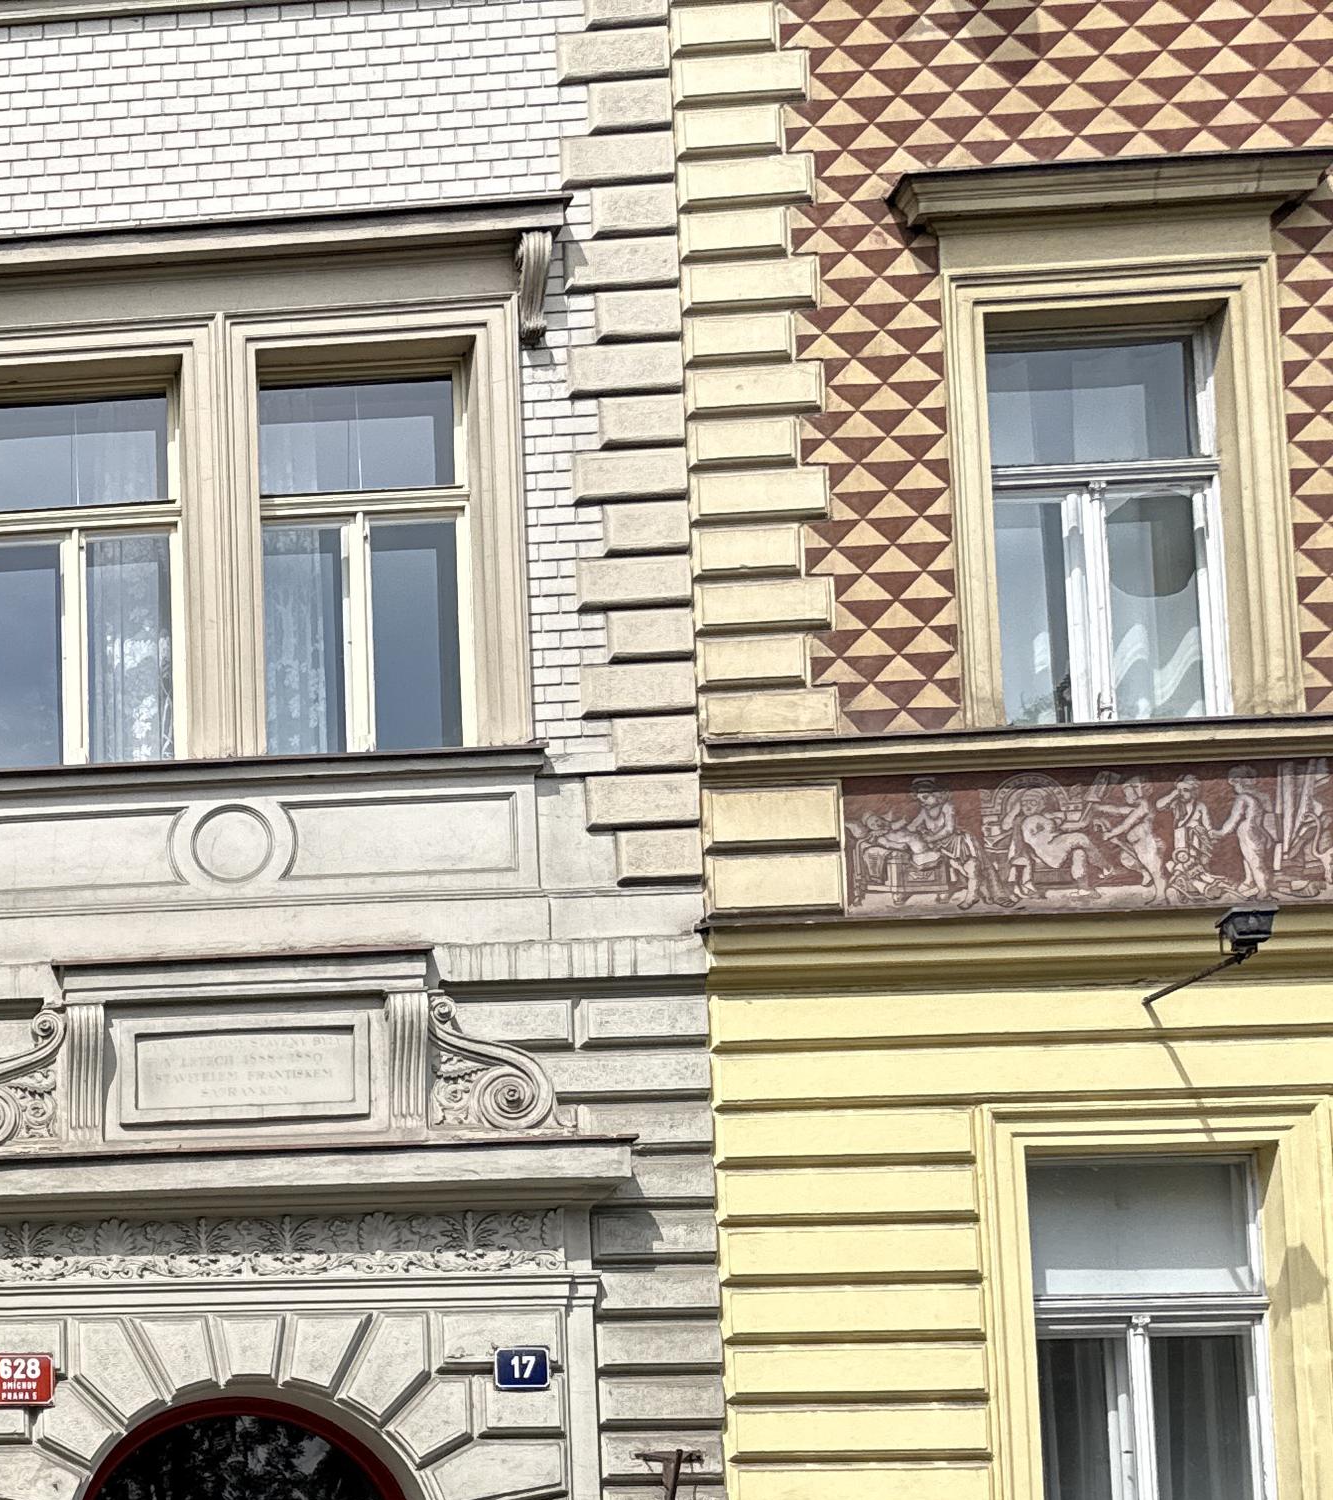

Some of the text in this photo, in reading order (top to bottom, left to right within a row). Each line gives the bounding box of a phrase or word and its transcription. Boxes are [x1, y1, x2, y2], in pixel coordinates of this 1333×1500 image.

[0, 1358, 41, 1379] 628
[510, 1355, 536, 1379] 17
[1, 1392, 30, 1400] PRAHA
